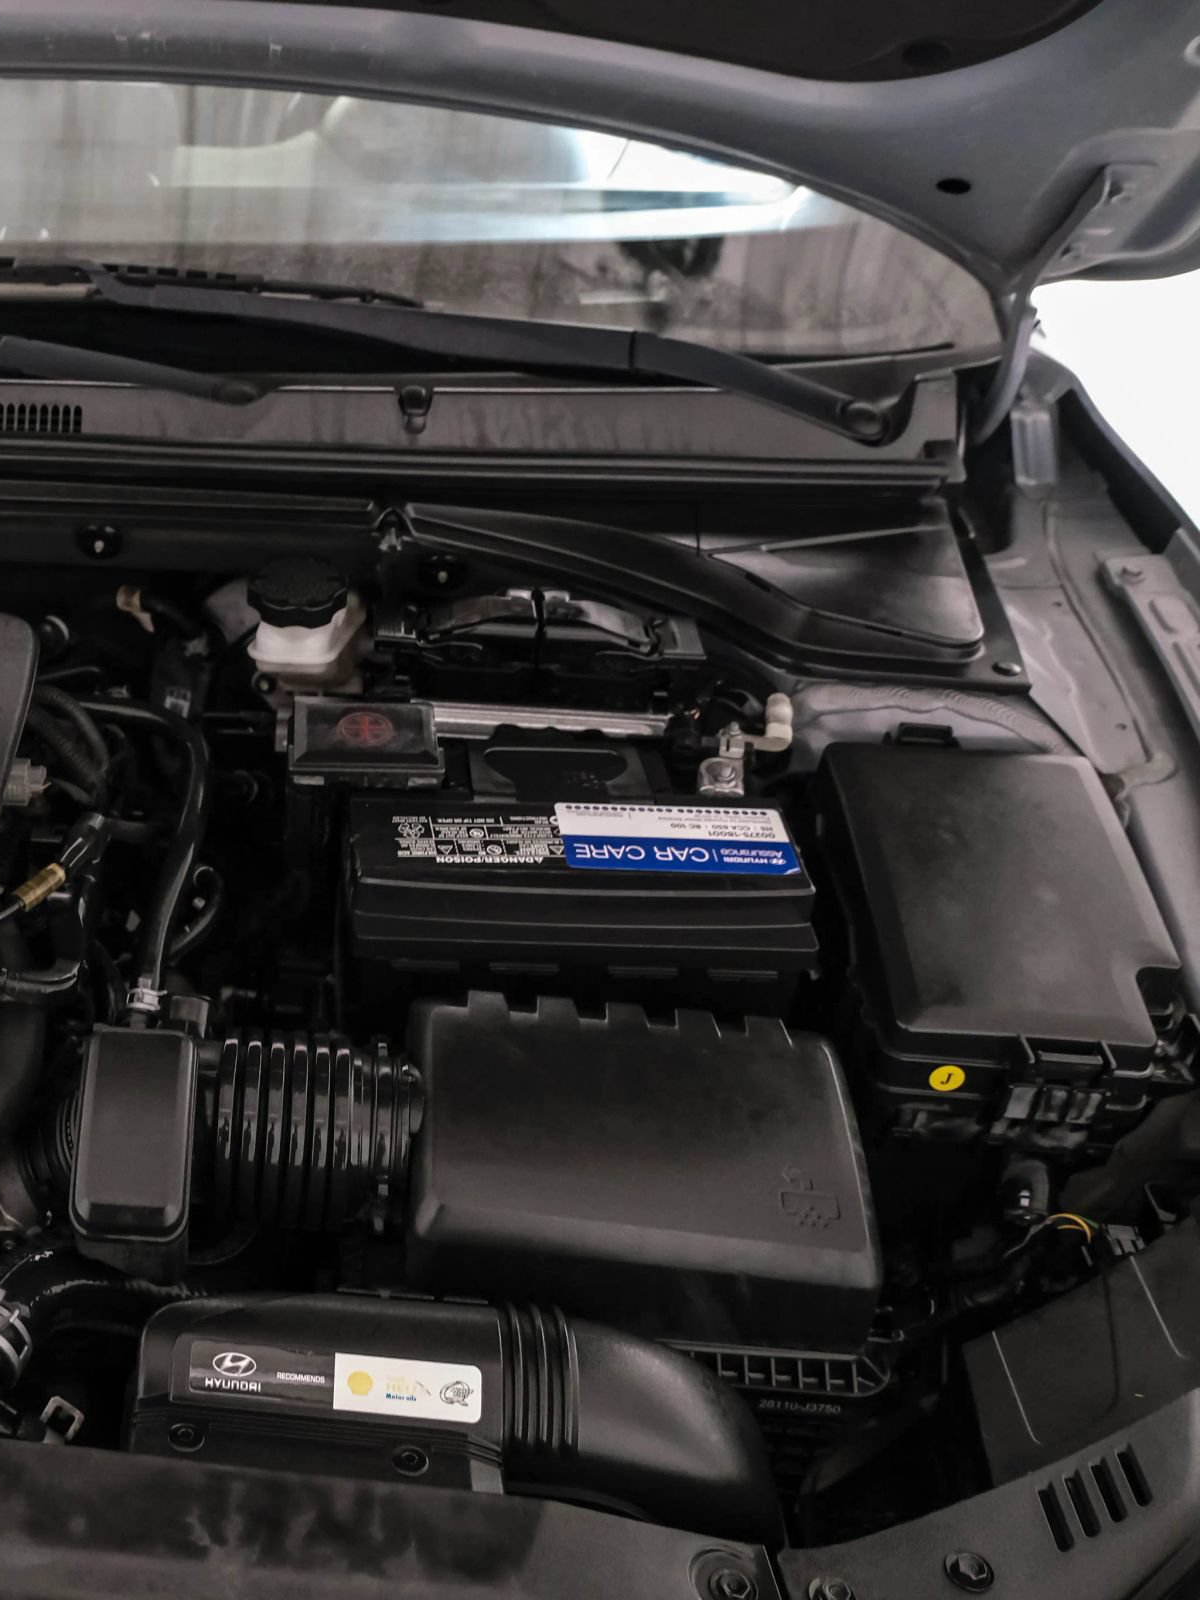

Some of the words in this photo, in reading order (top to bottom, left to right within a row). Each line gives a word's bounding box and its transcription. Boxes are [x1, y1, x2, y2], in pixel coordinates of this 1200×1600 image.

[572, 843, 646, 861] CARE
[653, 845, 710, 863] CAR
[436, 856, 535, 864] DANGER/POISON
[722, 857, 769, 865] HYUNDAI
[940, 1072, 955, 1085] J
[276, 1372, 326, 1384] RECOMMENDS
[205, 1378, 261, 1393] HYUNDAI
